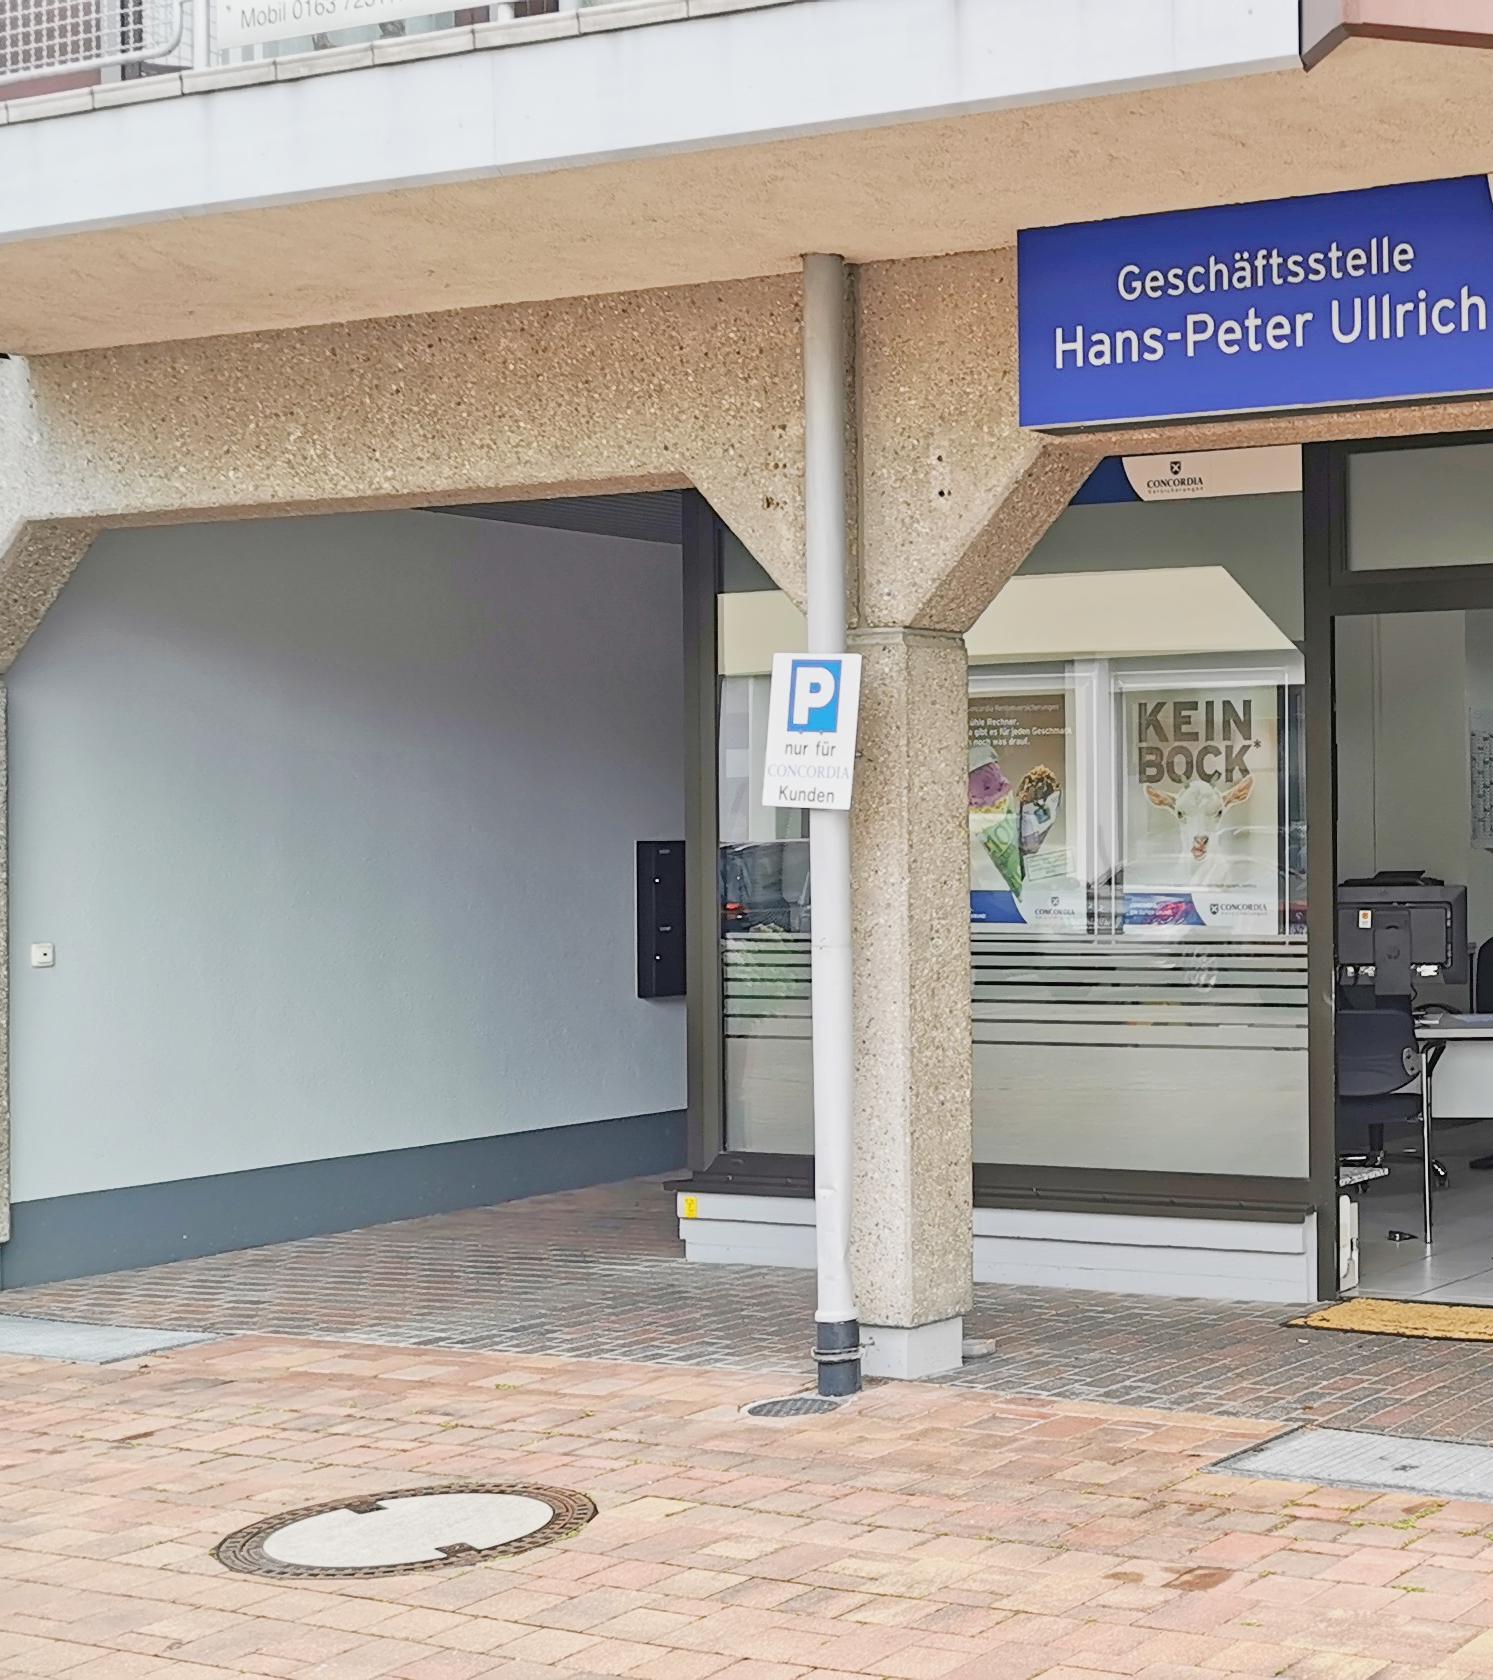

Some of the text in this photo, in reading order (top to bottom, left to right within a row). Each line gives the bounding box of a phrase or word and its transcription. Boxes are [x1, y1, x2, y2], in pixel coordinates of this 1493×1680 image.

[240, 6, 287, 29] Mobil
[1118, 236, 1415, 301] Geschäftsstelle
[1055, 285, 1487, 369] Hans-Peter Ullrich
[1146, 477, 1204, 489] CONCORDIA
[792, 667, 835, 725] P
[1138, 699, 1253, 743] KEIN
[785, 741, 836, 757] nur für
[767, 763, 849, 780] CONCORDIA
[779, 785, 835, 803] Kunden
[1219, 903, 1268, 911] CONCORDIA
